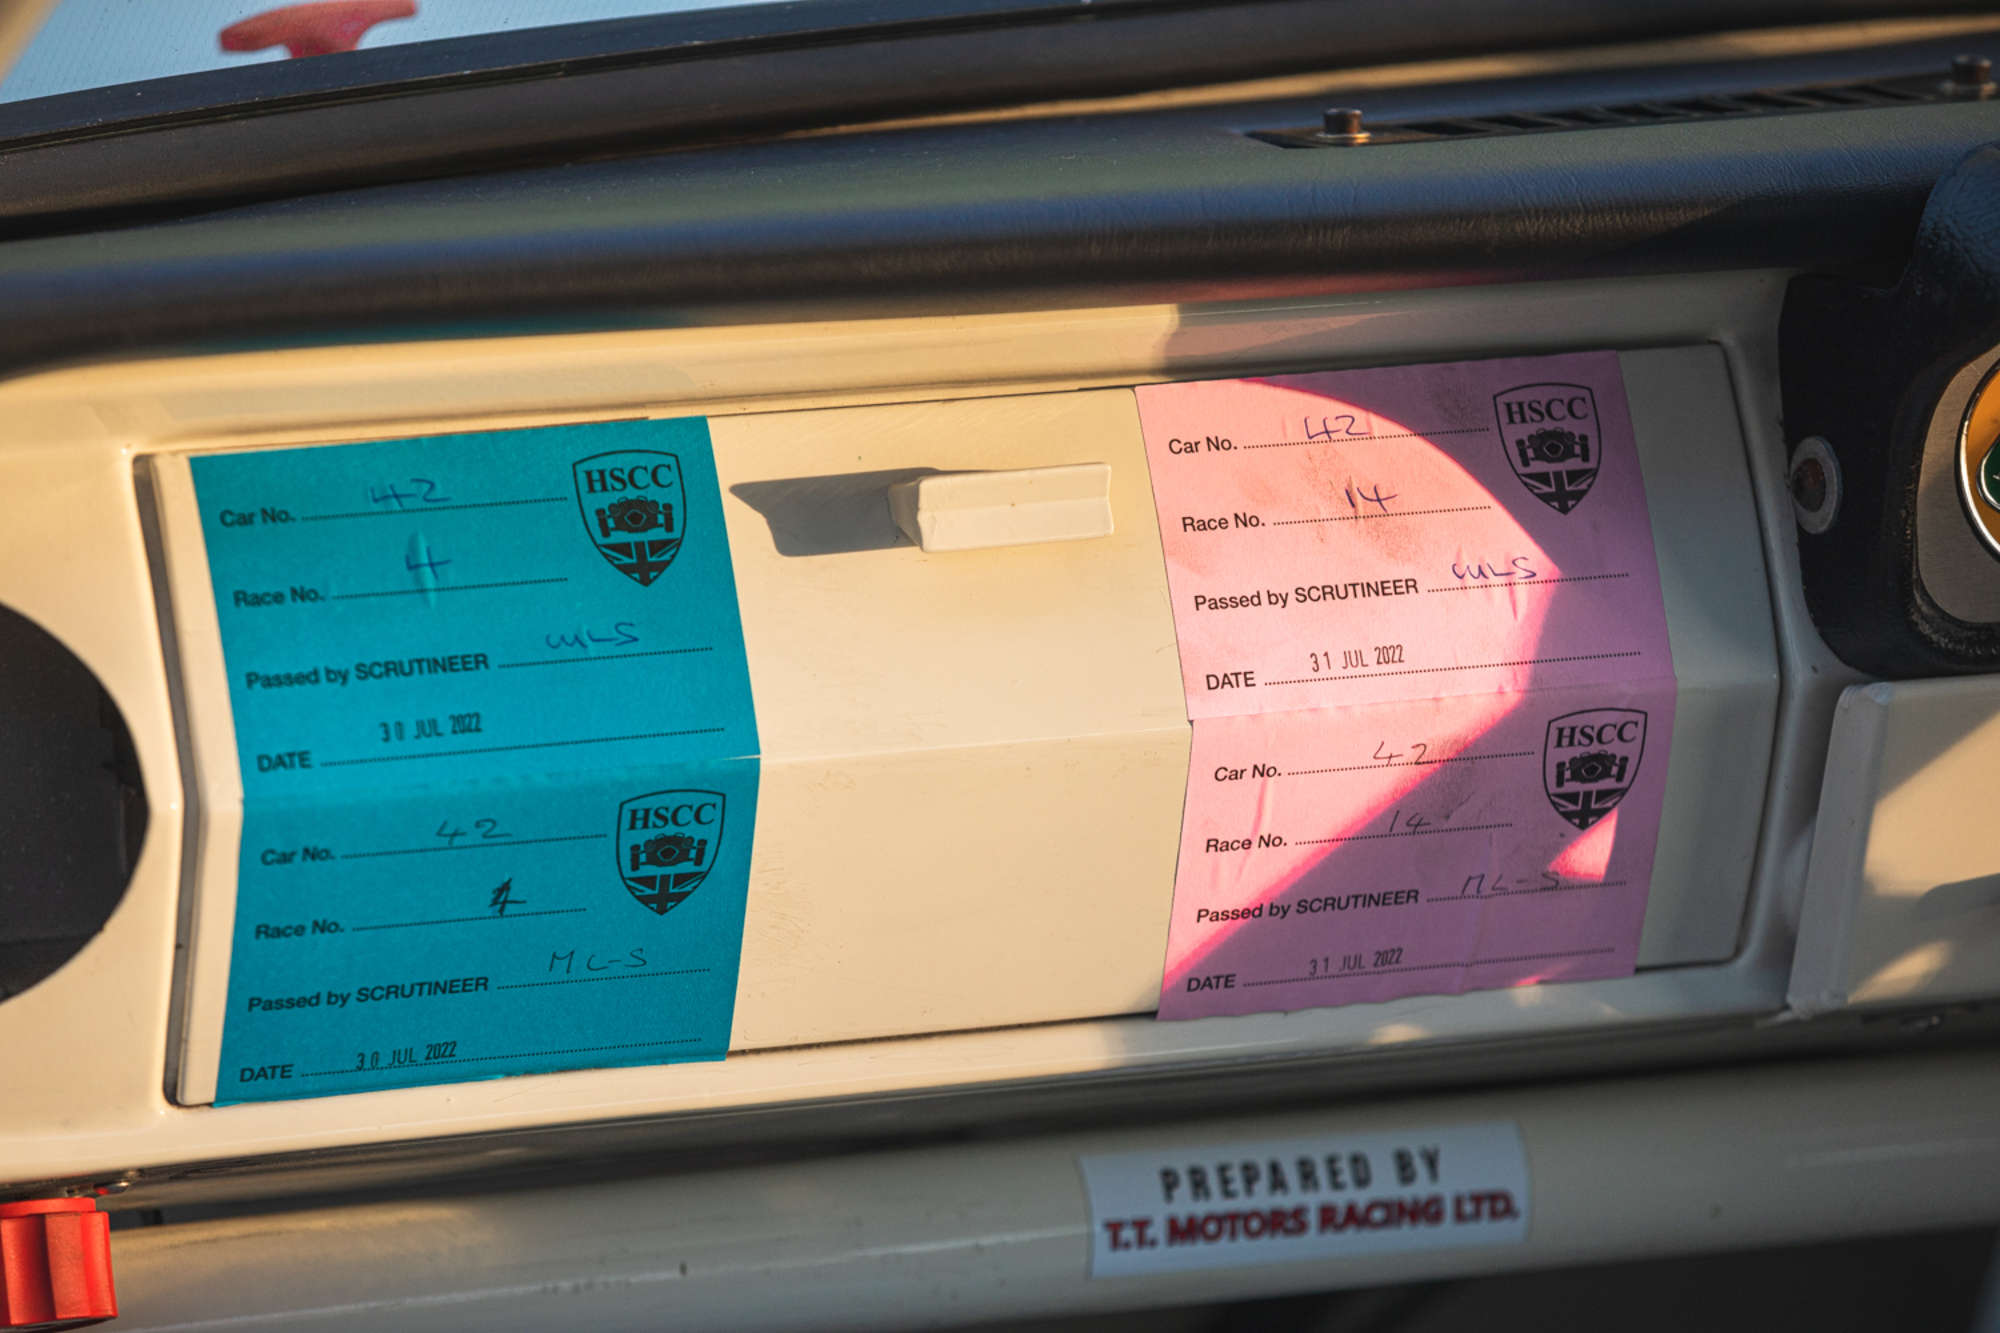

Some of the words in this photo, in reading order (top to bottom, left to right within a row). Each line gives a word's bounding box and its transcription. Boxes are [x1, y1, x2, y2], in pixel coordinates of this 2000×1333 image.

[1505, 396, 1590, 425] HSCC
[1304, 415, 1370, 440] 42
[1169, 438, 1200, 455] Car
[1207, 435, 1238, 452] No.
[370, 477, 452, 508] 42
[584, 463, 674, 494] HSCC
[1345, 484, 1398, 513] 14
[219, 508, 255, 527] Car
[261, 506, 296, 525] No.
[1182, 515, 1229, 533] Race
[1234, 512, 1266, 529] No.
[405, 545, 452, 580] 4
[234, 588, 285, 608] Race
[290, 585, 326, 603] No.
[1194, 593, 1262, 612] Passed
[1267, 590, 1289, 609] by
[1295, 577, 1419, 604] SCRUTINEER
[246, 667, 320, 689] Passed
[326, 666, 349, 687] by
[354, 653, 490, 681] SCRUTINEER
[1206, 671, 1257, 691] DATE
[1342, 648, 1369, 670] JUL
[1374, 644, 1405, 666] 2022
[256, 749, 312, 773] DATE
[413, 718, 444, 740] JUL
[448, 712, 482, 734] 2022
[1553, 720, 1640, 748] HSCC
[1372, 741, 1433, 766] 42
[1214, 765, 1247, 782] Car
[1252, 762, 1282, 779] No.
[627, 801, 717, 831] HSCC
[1388, 810, 1432, 835] 14
[435, 818, 512, 846] 42
[1205, 836, 1252, 853] Race
[1257, 833, 1288, 849] No.
[260, 848, 297, 866] Car
[302, 845, 336, 864] No.
[1196, 903, 1263, 923] Passed
[1268, 902, 1290, 919] by
[1296, 888, 1420, 914] SCRUTINEER
[254, 922, 306, 940] Race
[311, 918, 345, 935] No.
[1186, 973, 1237, 993] DATE
[1337, 952, 1366, 973] JUL
[1373, 947, 1404, 967] 2022
[248, 992, 320, 1012] Passed
[326, 991, 349, 1008] by
[355, 976, 488, 1003] SCRUTINEER
[239, 1063, 294, 1083] DATE
[388, 1047, 417, 1067] JUL
[425, 1040, 458, 1061] 2022
[1158, 1152, 1373, 1204] PREPARED
[1393, 1145, 1442, 1190] BY
[1104, 1218, 1158, 1252] T.T.
[1166, 1206, 1310, 1247] MOTORS
[1318, 1195, 1444, 1236] RACING
[1454, 1189, 1520, 1226] LTD.
